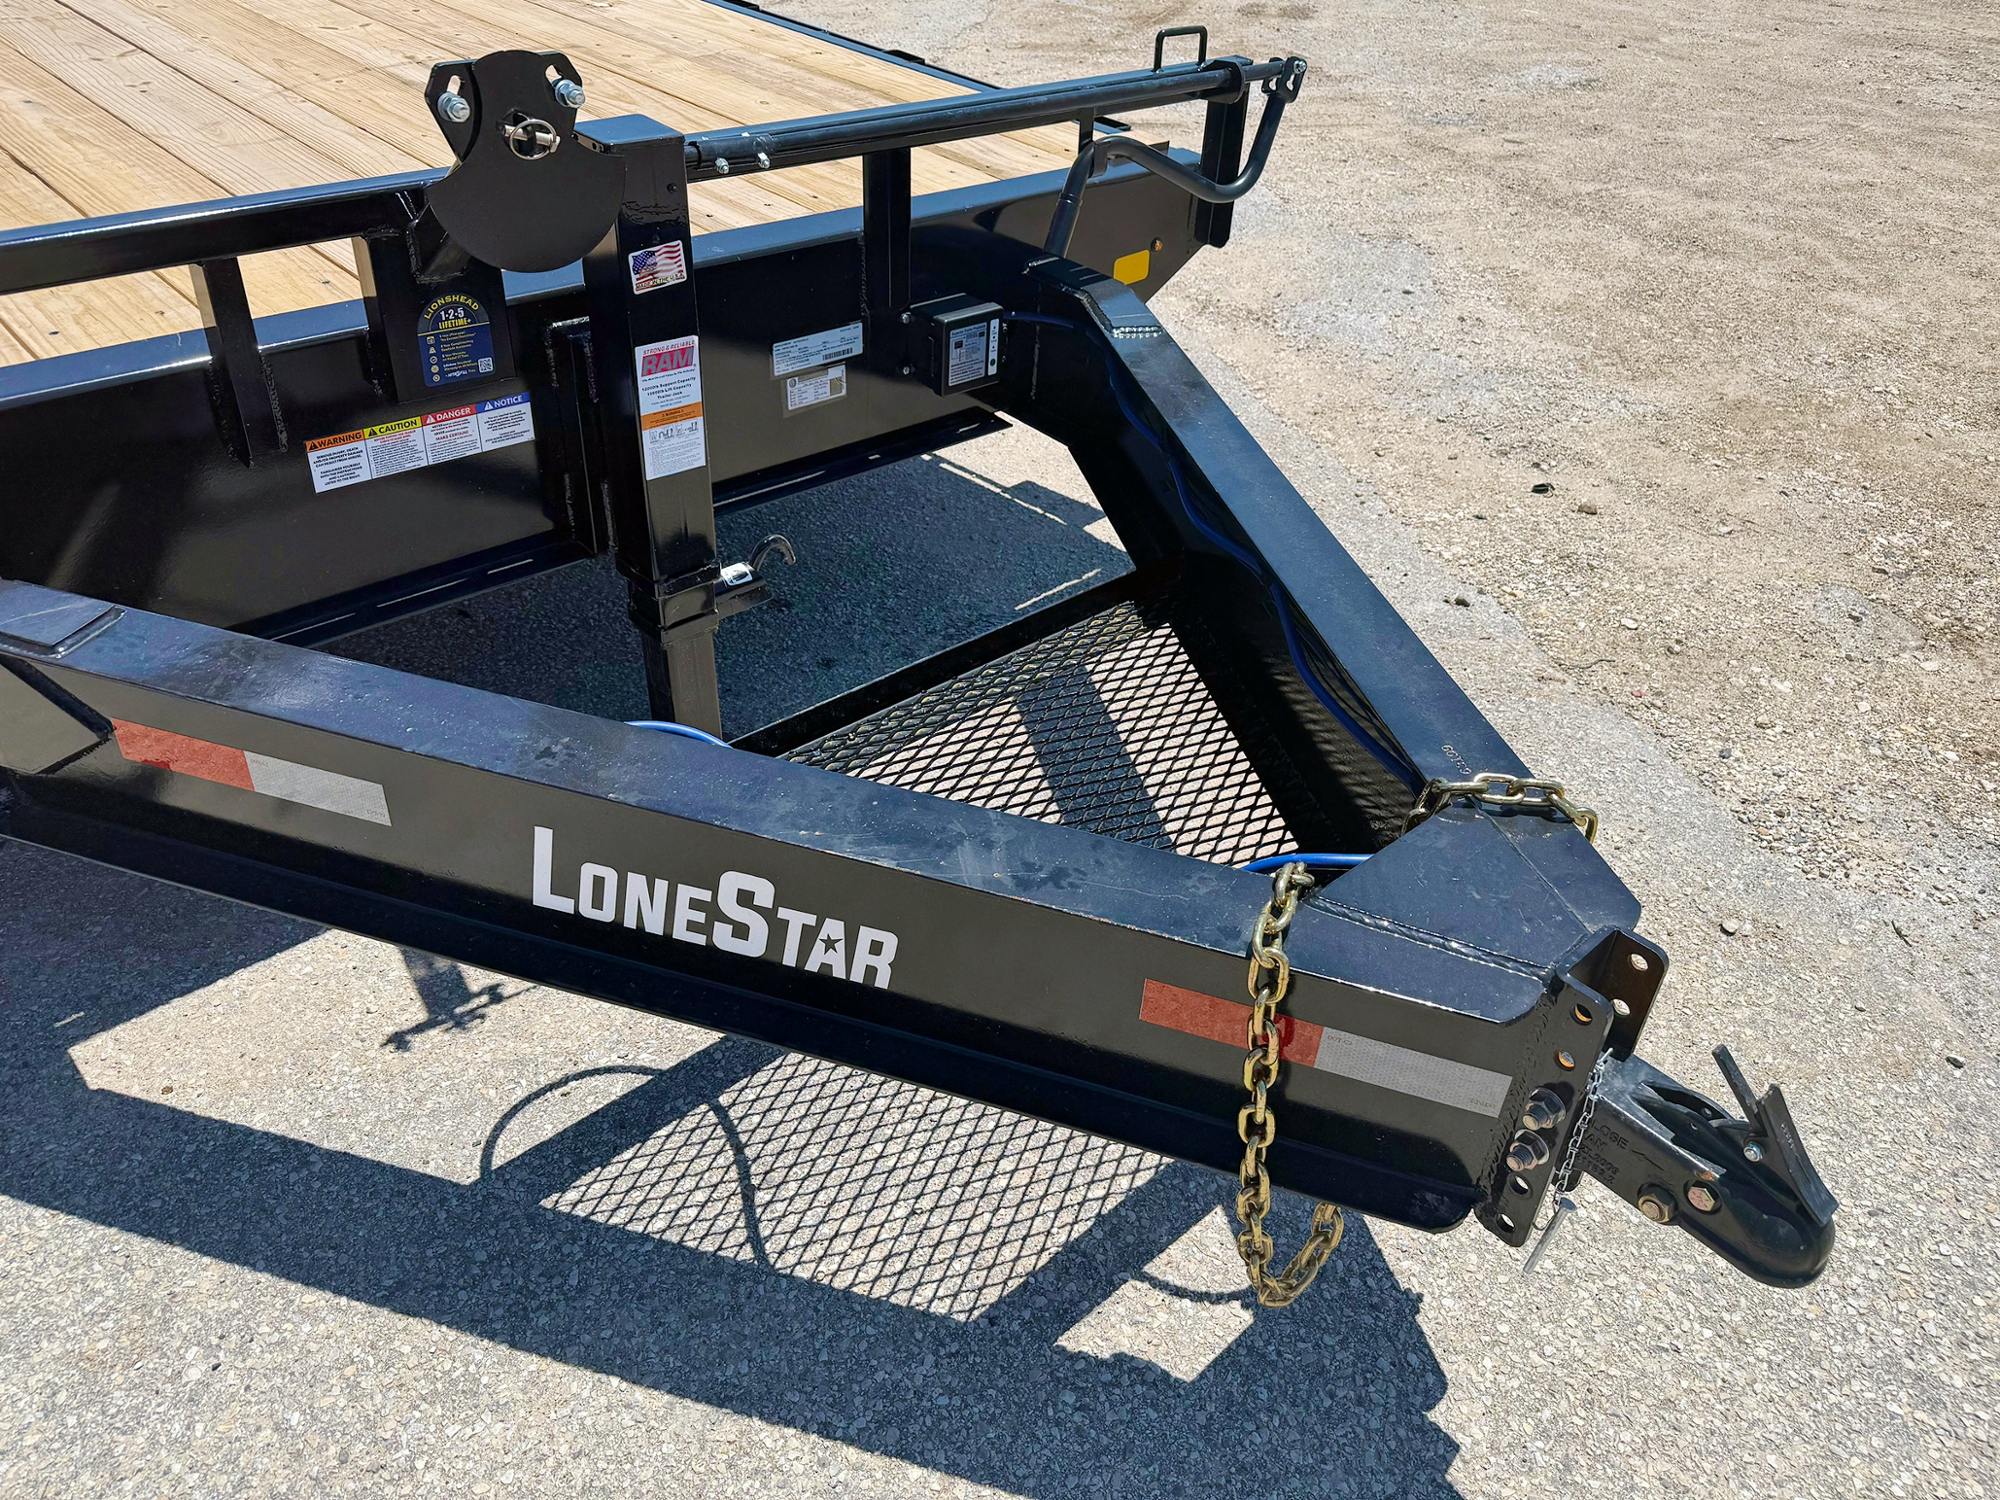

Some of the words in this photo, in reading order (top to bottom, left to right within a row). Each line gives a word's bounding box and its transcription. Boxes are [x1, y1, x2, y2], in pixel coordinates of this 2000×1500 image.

[424, 295, 479, 319] LIONSHEAD
[643, 345, 664, 355] STRONG
[641, 346, 695, 377] RAM
[494, 395, 523, 408] NOTICE
[436, 407, 471, 421] DANGER
[379, 419, 418, 433] CAUTION
[317, 432, 362, 447] WARNING
